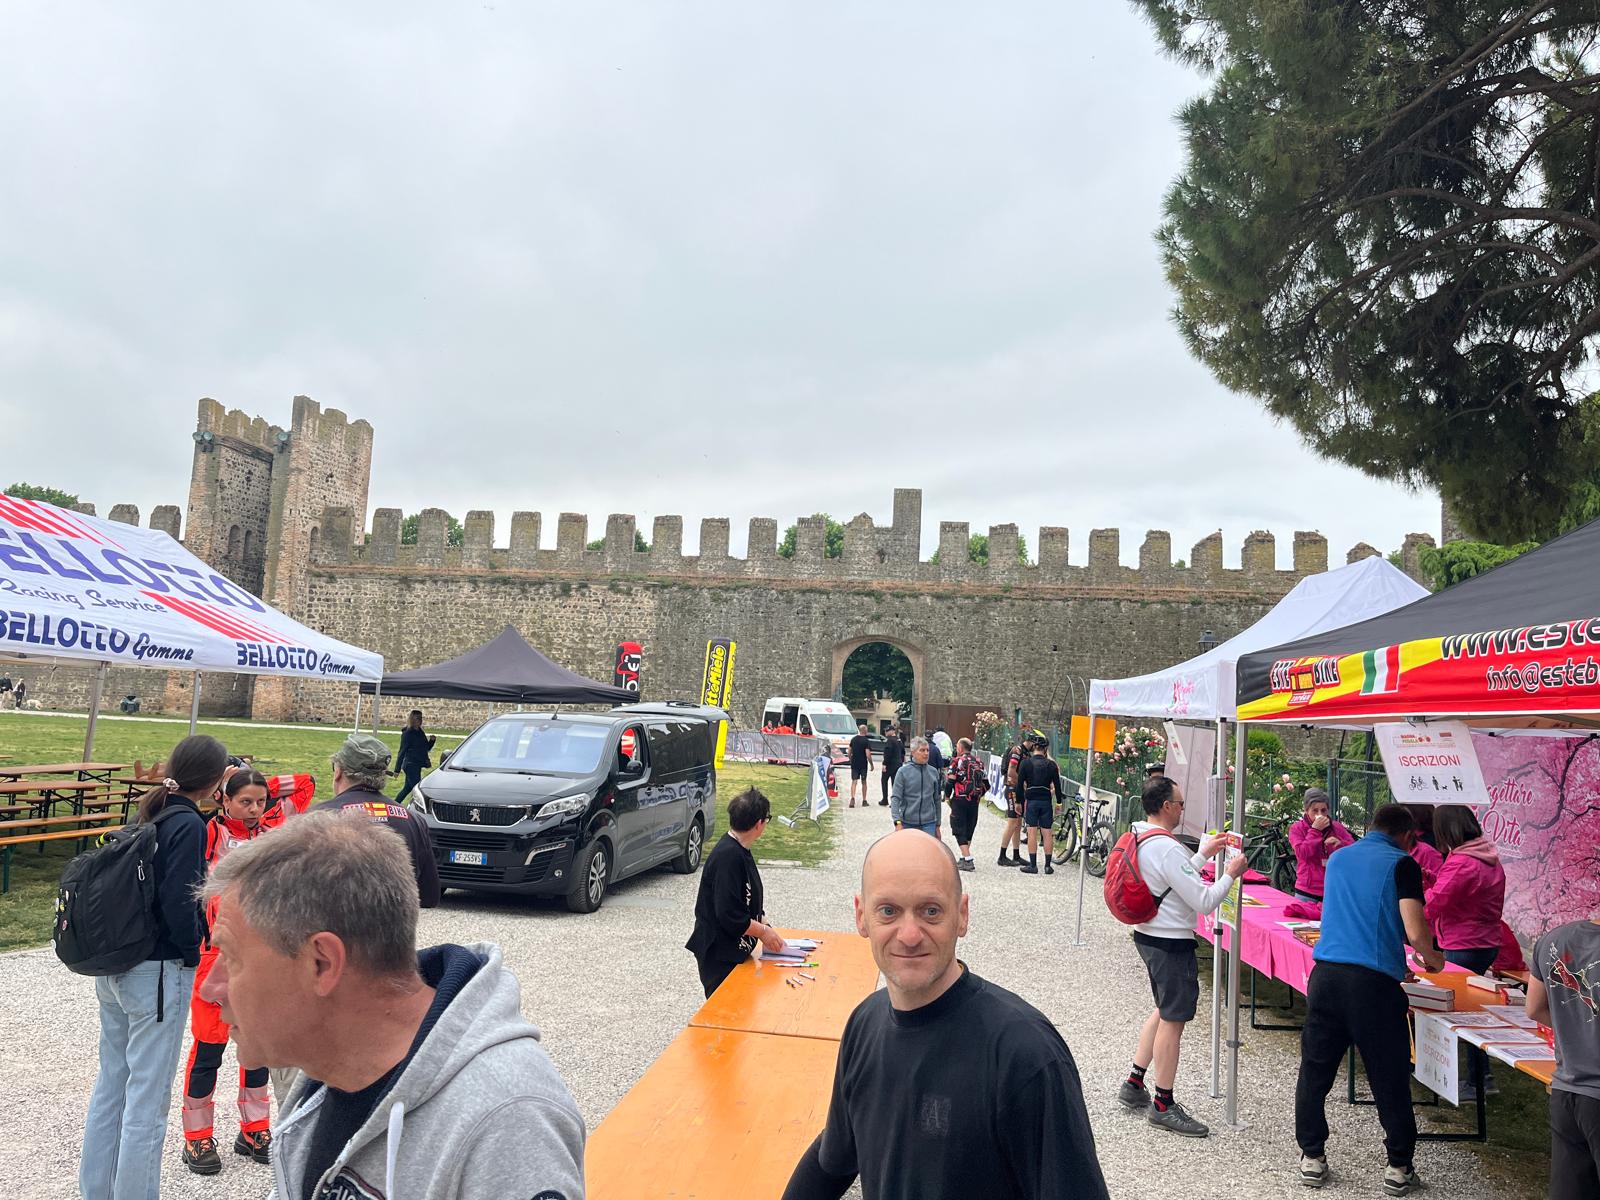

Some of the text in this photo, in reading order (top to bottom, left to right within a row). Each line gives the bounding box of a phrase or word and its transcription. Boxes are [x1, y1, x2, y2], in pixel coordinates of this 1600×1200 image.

[85, 588, 168, 613] Service
[132, 632, 194, 661] Gomme
[236, 641, 356, 676] BELLOTTO Gomme
[1398, 754, 1461, 767] ISCRIZIONI
[388, 804, 408, 818] BIKE
[1483, 810, 1522, 847] Vita
